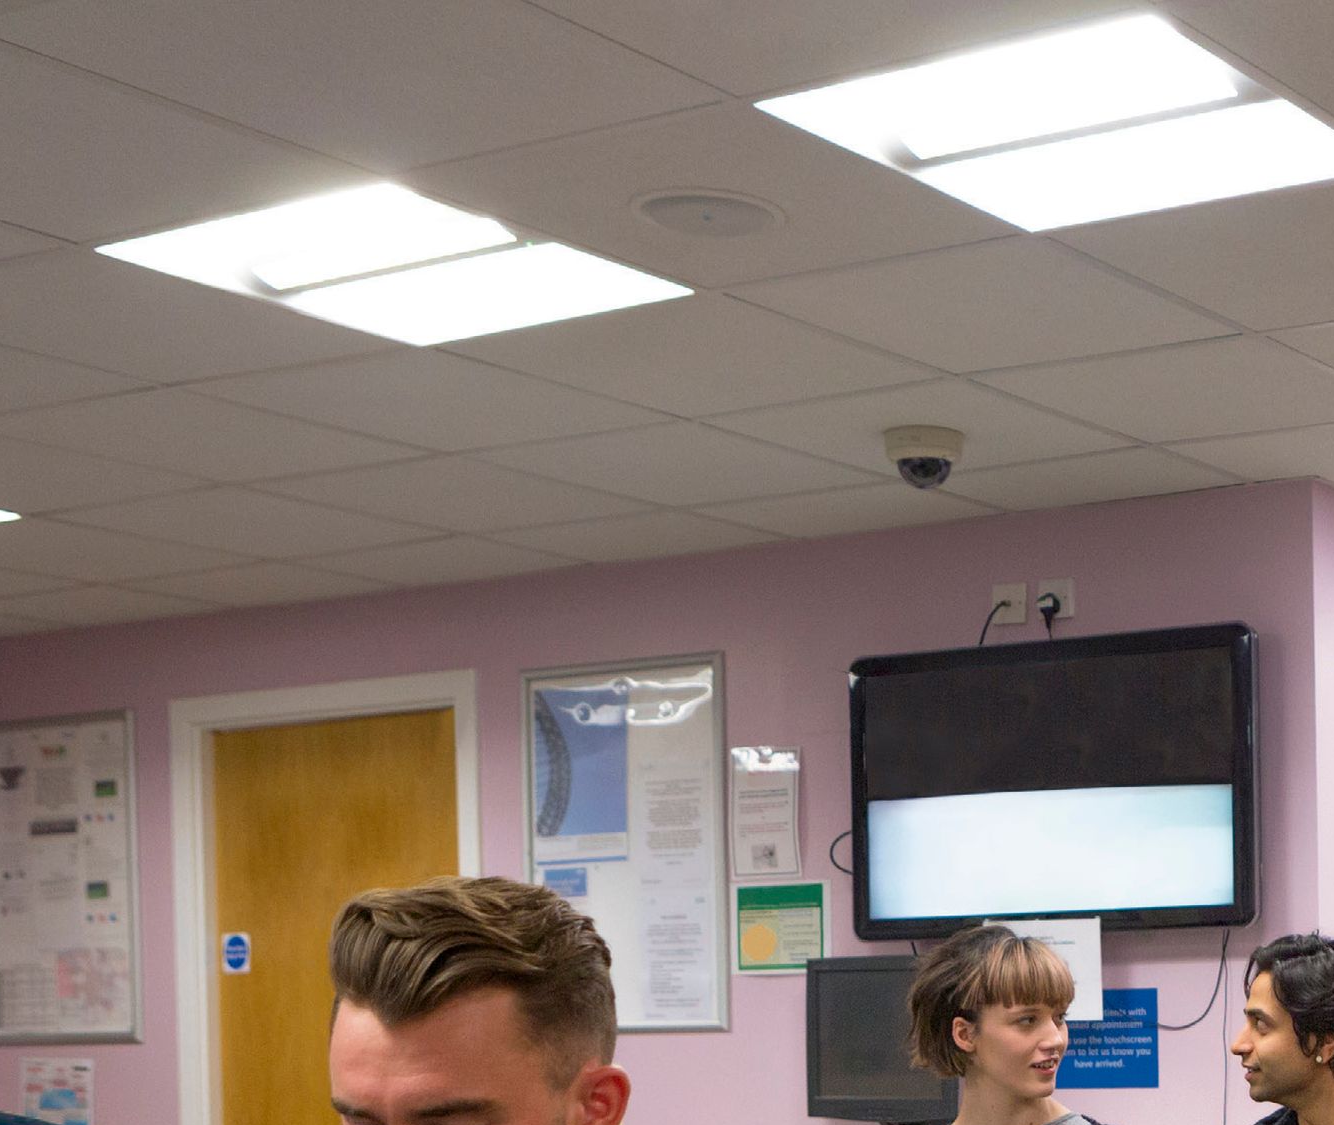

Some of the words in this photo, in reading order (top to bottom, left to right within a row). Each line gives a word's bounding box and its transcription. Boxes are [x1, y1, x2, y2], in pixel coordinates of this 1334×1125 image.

[1104, 1008, 1126, 1016] tients
[1128, 1007, 1147, 1016] with
[1091, 1021, 1143, 1030] appointment
[1089, 1036, 1102, 1044] the
[1104, 1035, 1152, 1045] touchscreen
[1077, 1048, 1086, 1056] to
[1088, 1047, 1099, 1056] let
[1101, 1048, 1110, 1056] us
[1112, 1047, 1134, 1056] know
[1136, 1048, 1152, 1058] you
[1074, 1059, 1093, 1068] have
